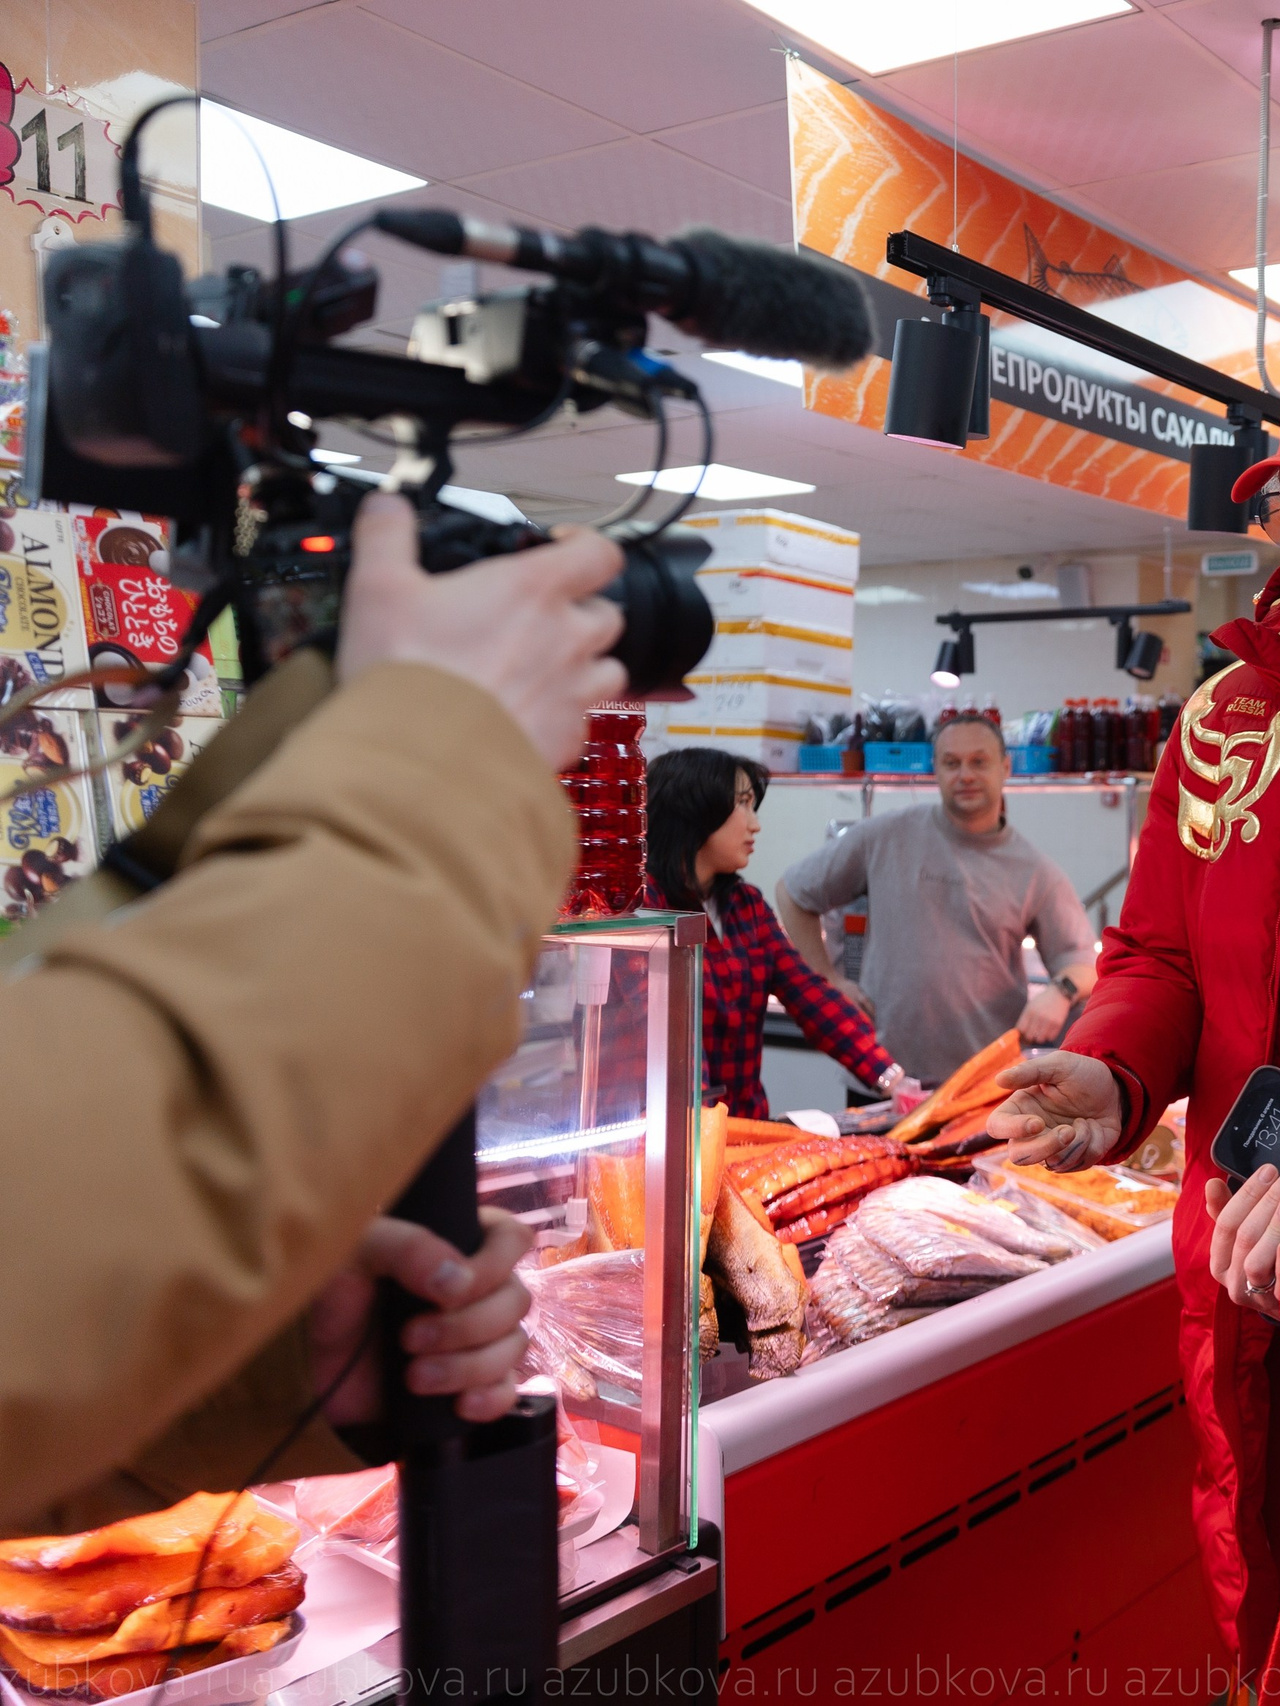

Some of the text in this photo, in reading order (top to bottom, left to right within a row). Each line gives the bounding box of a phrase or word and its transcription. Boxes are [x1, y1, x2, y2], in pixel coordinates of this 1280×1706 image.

[21, 108, 94, 205] 11
[54, 519, 64, 544] LOTTE
[15, 576, 29, 632] CHOCOLATE
[21, 531, 65, 682] ALMOND
[102, 590, 116, 635] CHOCOLAT
[118, 578, 155, 649] ひととき
[146, 576, 179, 655] おもちの
[1226, 704, 1265, 716] RUSSIA
[1234, 697, 1267, 709] TEAM
[1243, 1118, 1264, 1148] Понедельник,
[1263, 1098, 1274, 1114] апреля
